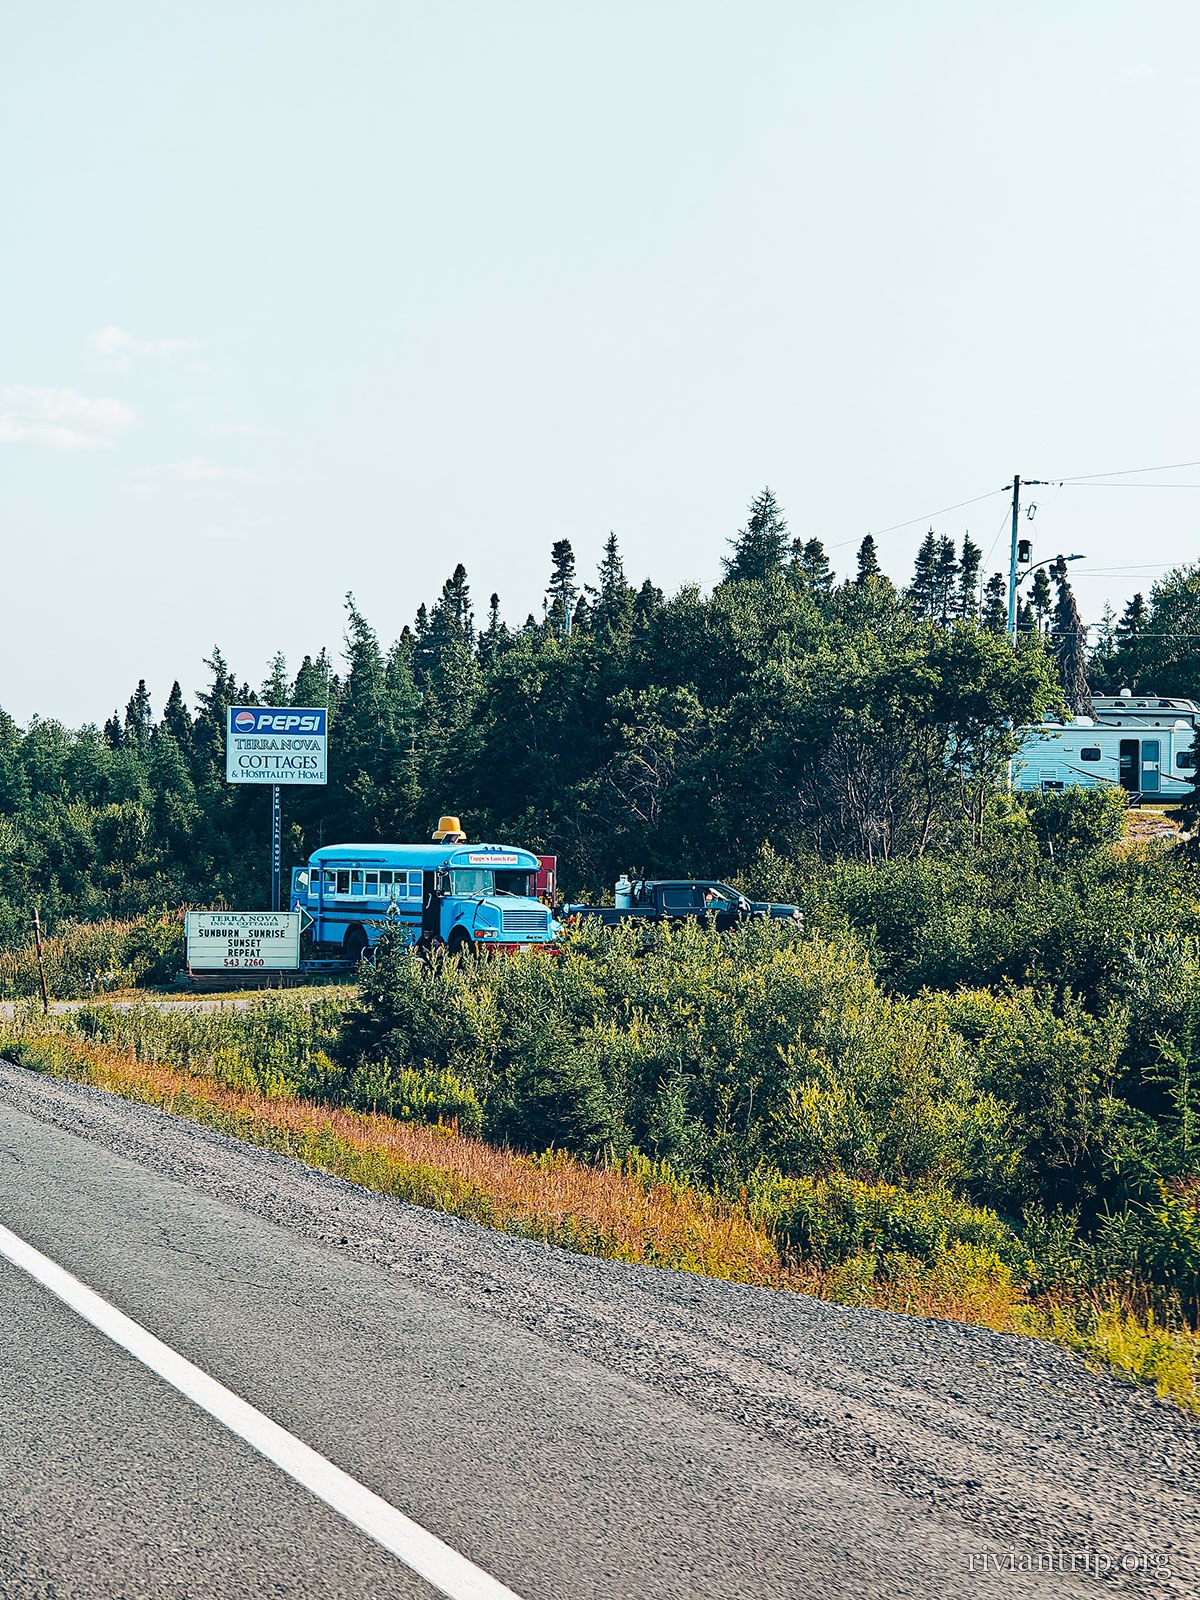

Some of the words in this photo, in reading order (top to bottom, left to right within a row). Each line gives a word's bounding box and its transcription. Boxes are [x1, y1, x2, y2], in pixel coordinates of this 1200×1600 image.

[256, 715, 321, 731] PEPSI
[234, 739, 280, 751] TERRA
[280, 739, 322, 751] NOVA
[238, 755, 318, 769] COTTAGES
[231, 770, 239, 778] &
[198, 929, 240, 938] SUNBURN
[248, 929, 286, 938] SUNRISE
[227, 939, 261, 948] SUNSET
[227, 948, 261, 957] REPEAT
[223, 958, 240, 967] 543
[244, 958, 265, 967] 2260
